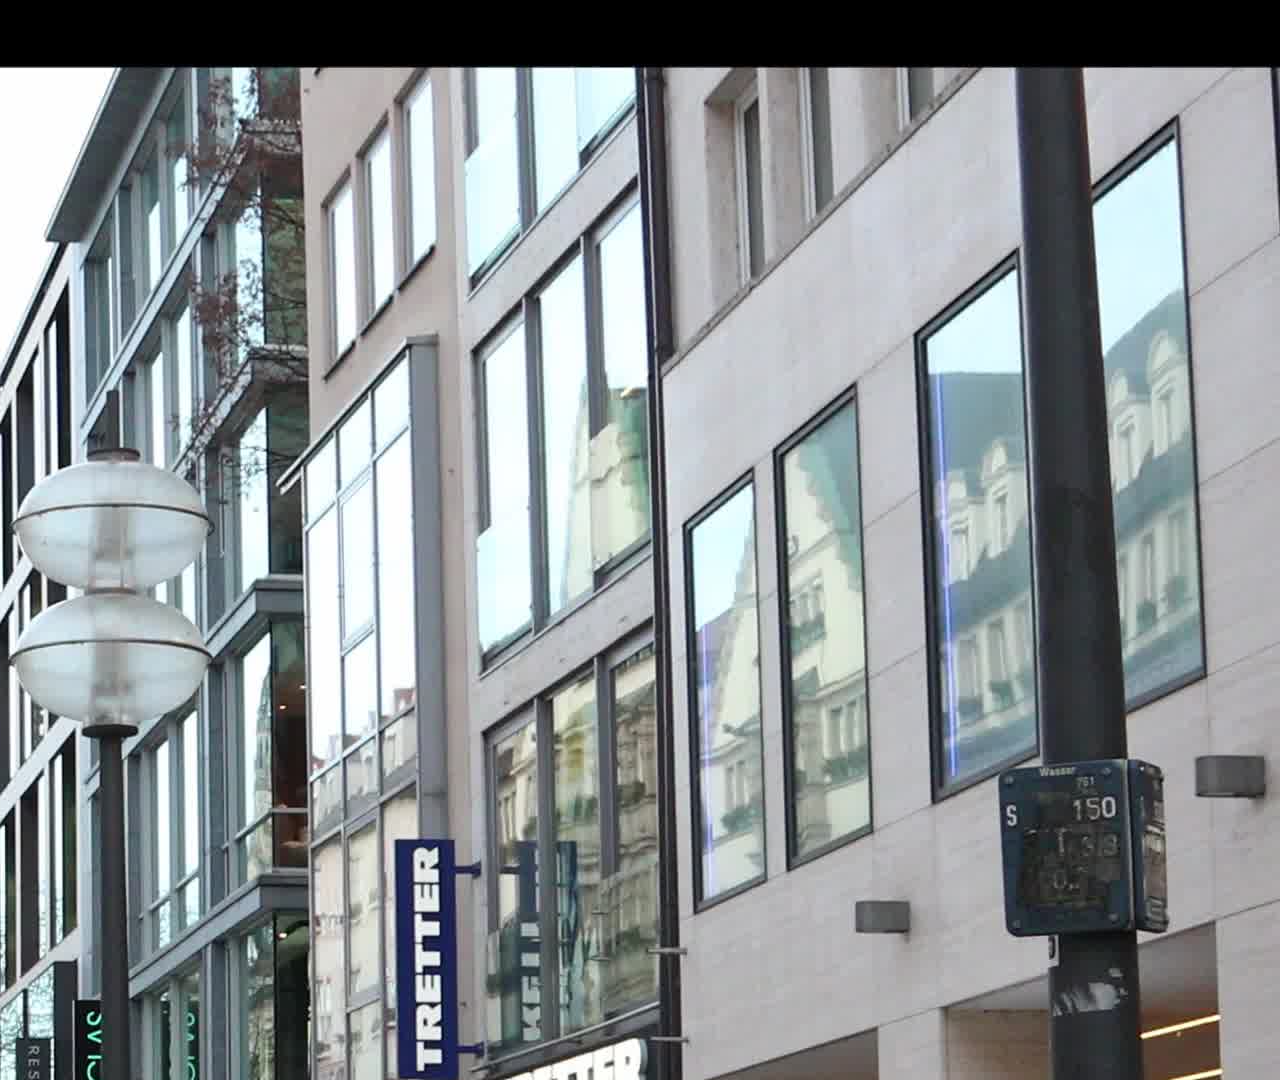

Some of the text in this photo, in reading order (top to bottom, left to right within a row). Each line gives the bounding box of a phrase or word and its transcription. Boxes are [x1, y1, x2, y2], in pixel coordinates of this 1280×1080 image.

[1006, 796, 1116, 826] S 150
[412, 847, 443, 1073] TRETTER
